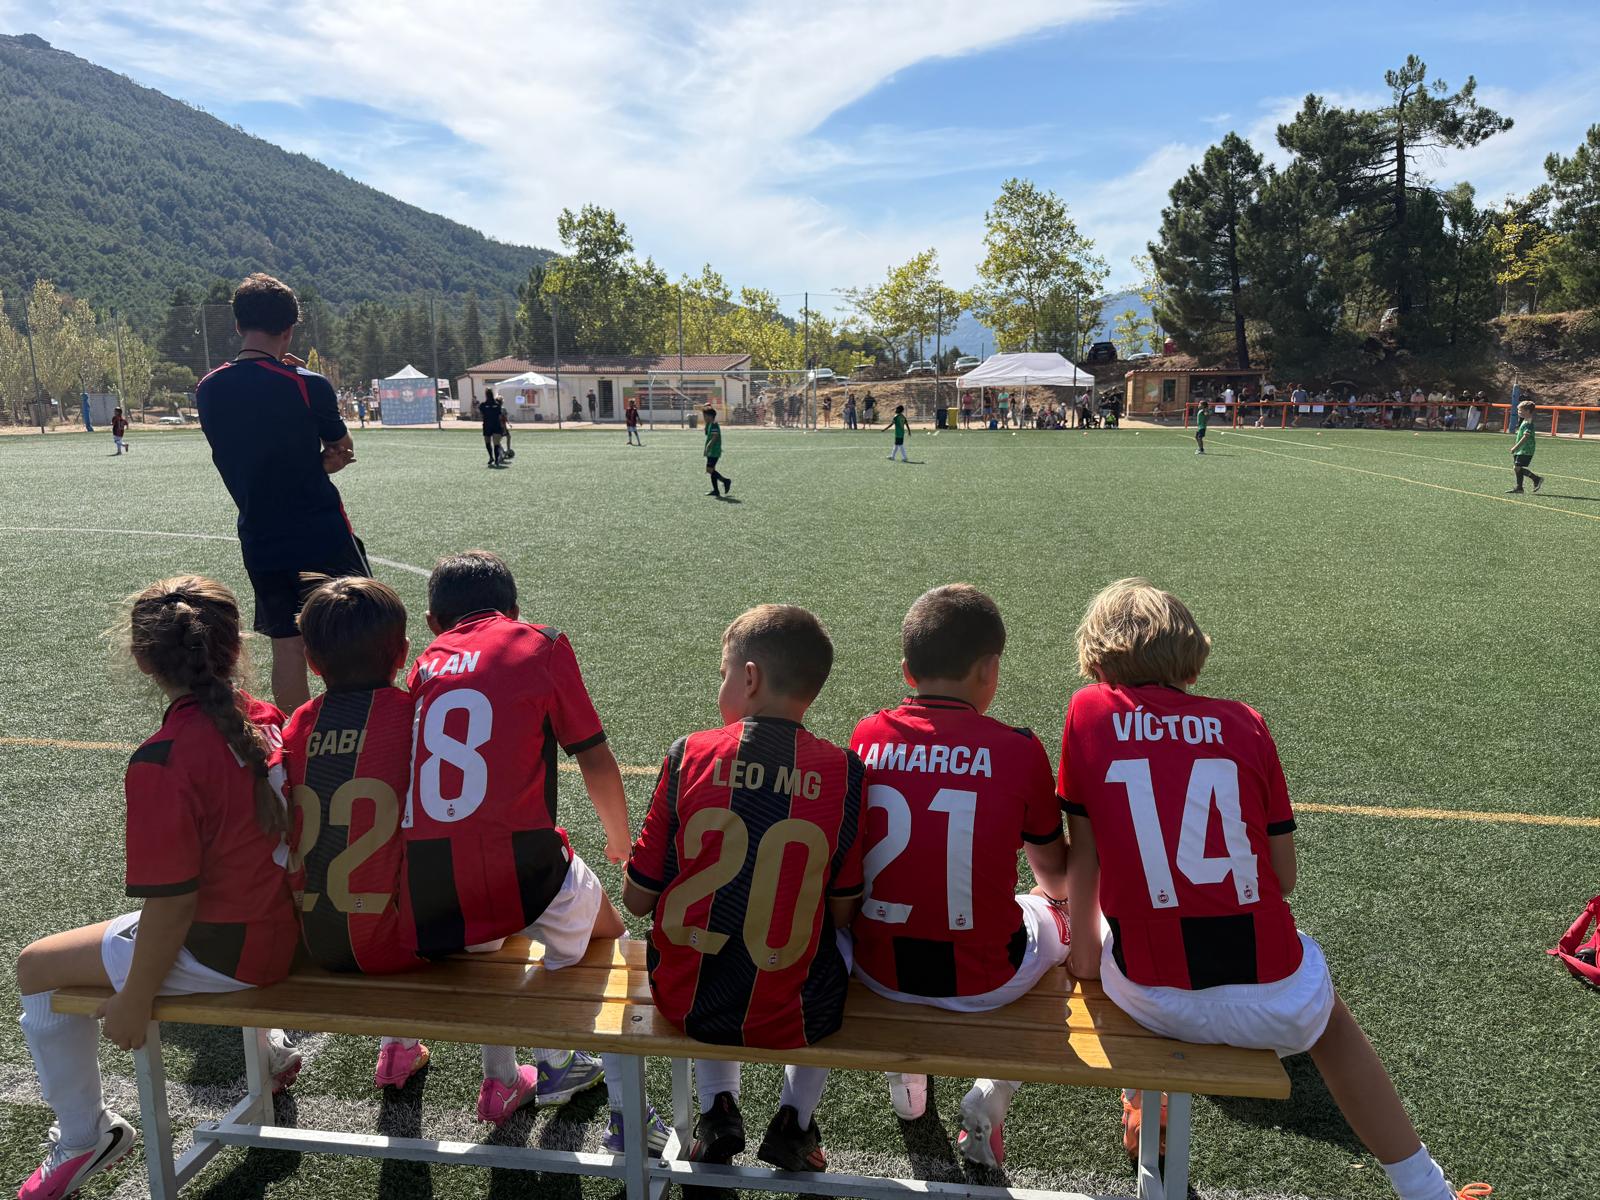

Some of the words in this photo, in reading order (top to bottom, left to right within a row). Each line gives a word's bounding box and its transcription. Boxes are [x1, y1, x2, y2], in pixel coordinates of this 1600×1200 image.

[306, 729, 366, 757] GABI
[1112, 705, 1224, 744] VÍCTOR
[713, 759, 764, 790] LEO
[774, 769, 822, 800] MG
[861, 784, 977, 930] 21
[1104, 758, 1260, 909] 14
[661, 807, 829, 972] 20
